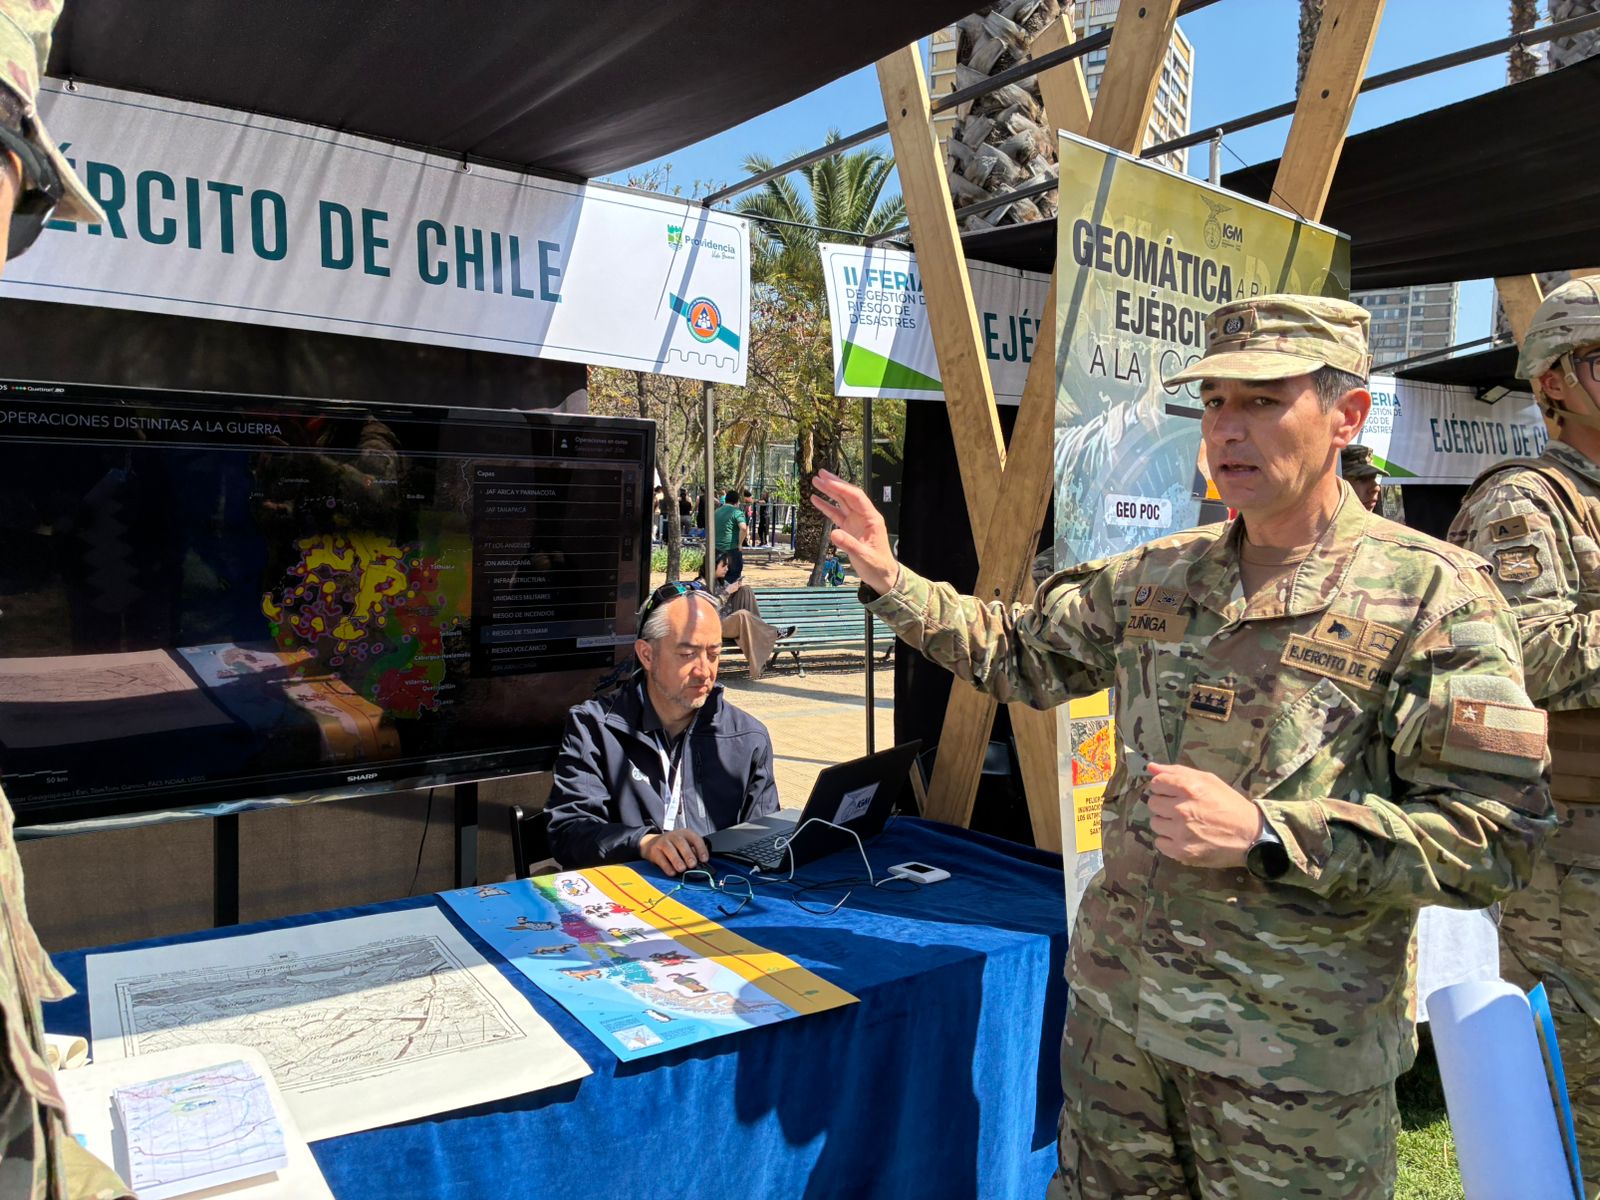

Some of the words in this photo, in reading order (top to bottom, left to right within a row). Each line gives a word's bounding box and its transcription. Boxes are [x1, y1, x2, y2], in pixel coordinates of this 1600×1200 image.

[1223, 223, 1243, 243] IGM
[319, 199, 391, 278] DE
[417, 219, 563, 304] CHILE
[684, 234, 736, 255] Providencia
[1072, 218, 1232, 305] GEOMÁTICA
[843, 266, 858, 286] II
[846, 288, 863, 299] DE
[866, 290, 916, 305] GESTIÓN
[848, 301, 891, 315] RIESGO
[895, 305, 910, 317] DE
[850, 314, 916, 329] DESASTRES
[1090, 344, 1107, 376] A
[1115, 348, 1142, 384] LA
[114, 416, 189, 432] DISTINTAS
[193, 418, 202, 431] A
[206, 419, 224, 433] LA
[226, 421, 283, 436] GUERRA
[1380, 417, 1390, 425] DE
[1430, 414, 1508, 456] EJÉRCITO
[1510, 424, 1532, 457] DE
[1116, 501, 1138, 519] GEO
[1140, 503, 1161, 521] POC
[492, 611, 514, 619] RIESGO
[523, 609, 555, 618] INCENDIOS
[1127, 614, 1166, 633] ZUÑIGA
[492, 629, 514, 637] RIESGO
[523, 627, 549, 636] TSUNAMI
[491, 646, 513, 654] RIESGO
[1289, 645, 1347, 672] EJERCITO
[1348, 661, 1367, 678] DE
[346, 772, 378, 783] SHARP
